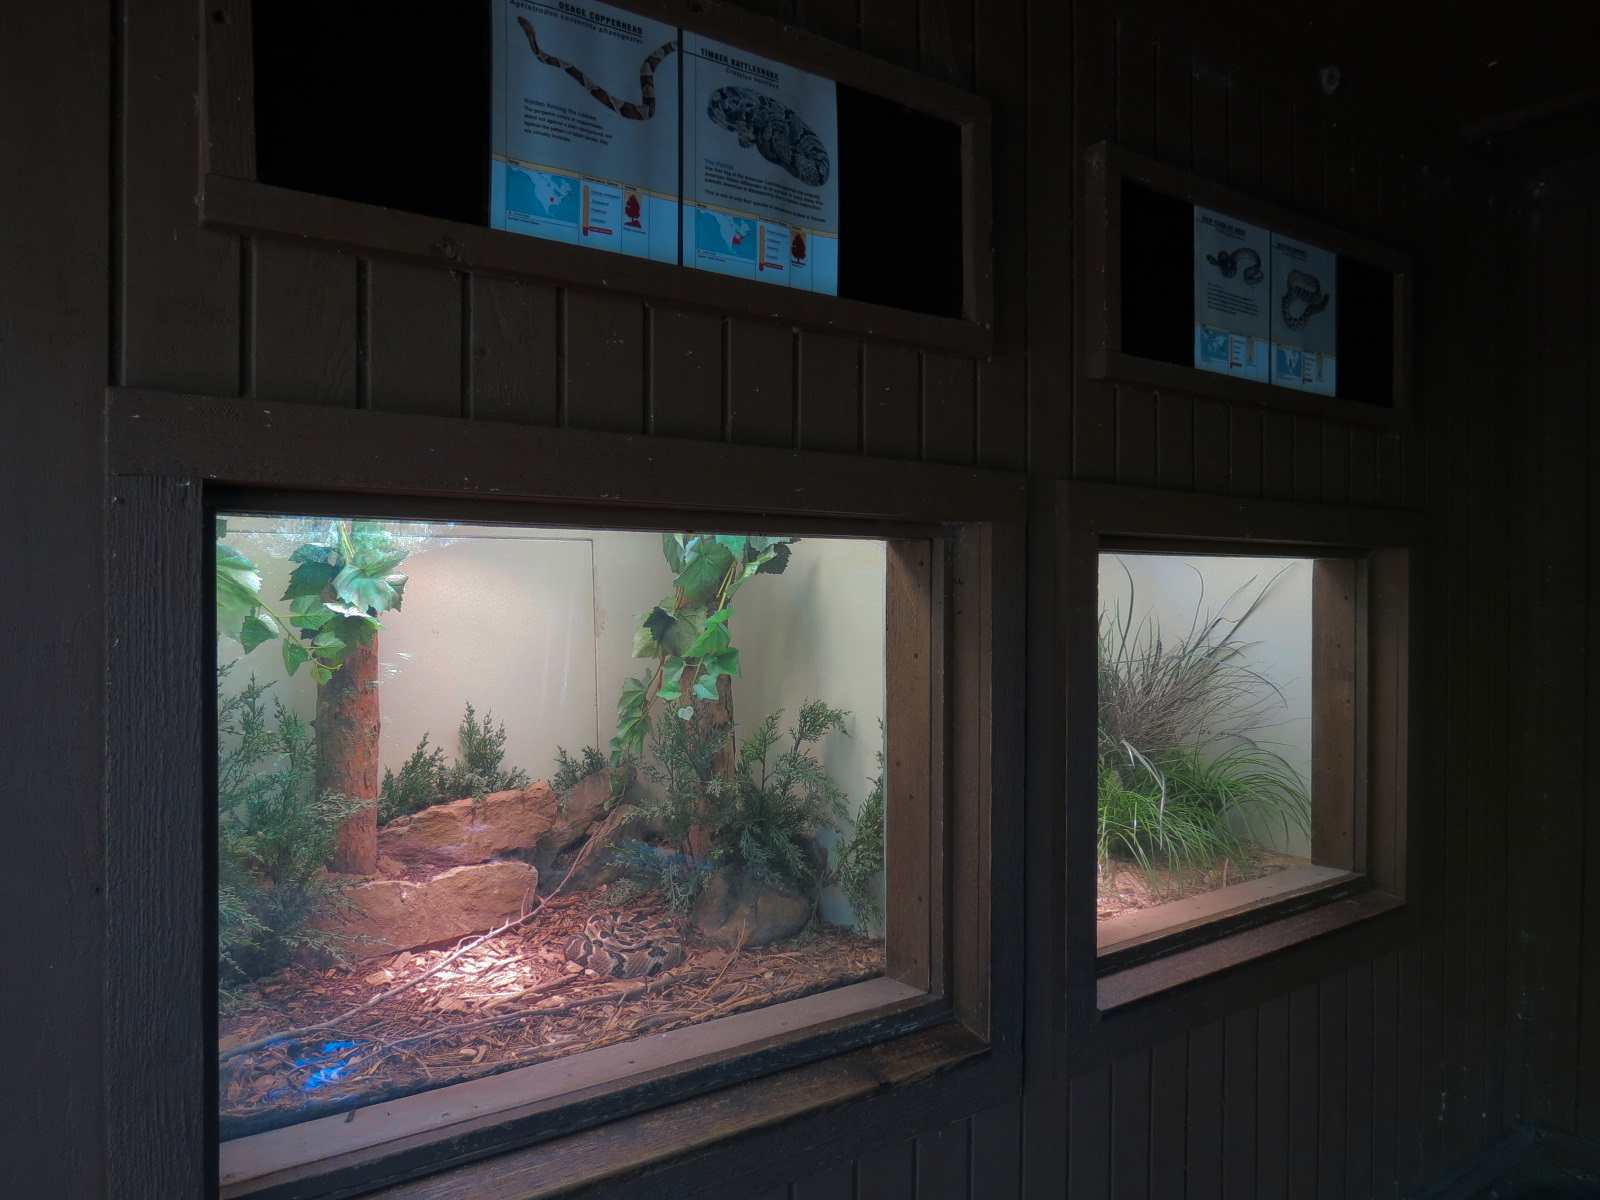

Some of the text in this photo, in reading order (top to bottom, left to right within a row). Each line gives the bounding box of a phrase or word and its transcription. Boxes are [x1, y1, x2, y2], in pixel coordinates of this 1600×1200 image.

[510, 0, 558, 18] Agkistrodon
[560, 15, 596, 31] contortrix
[559, 1, 643, 35] OSAGE COPPERHEAD
[701, 48, 779, 80] TIMBER RATTLESNAKE
[725, 67, 780, 89] Crotalus horridus
